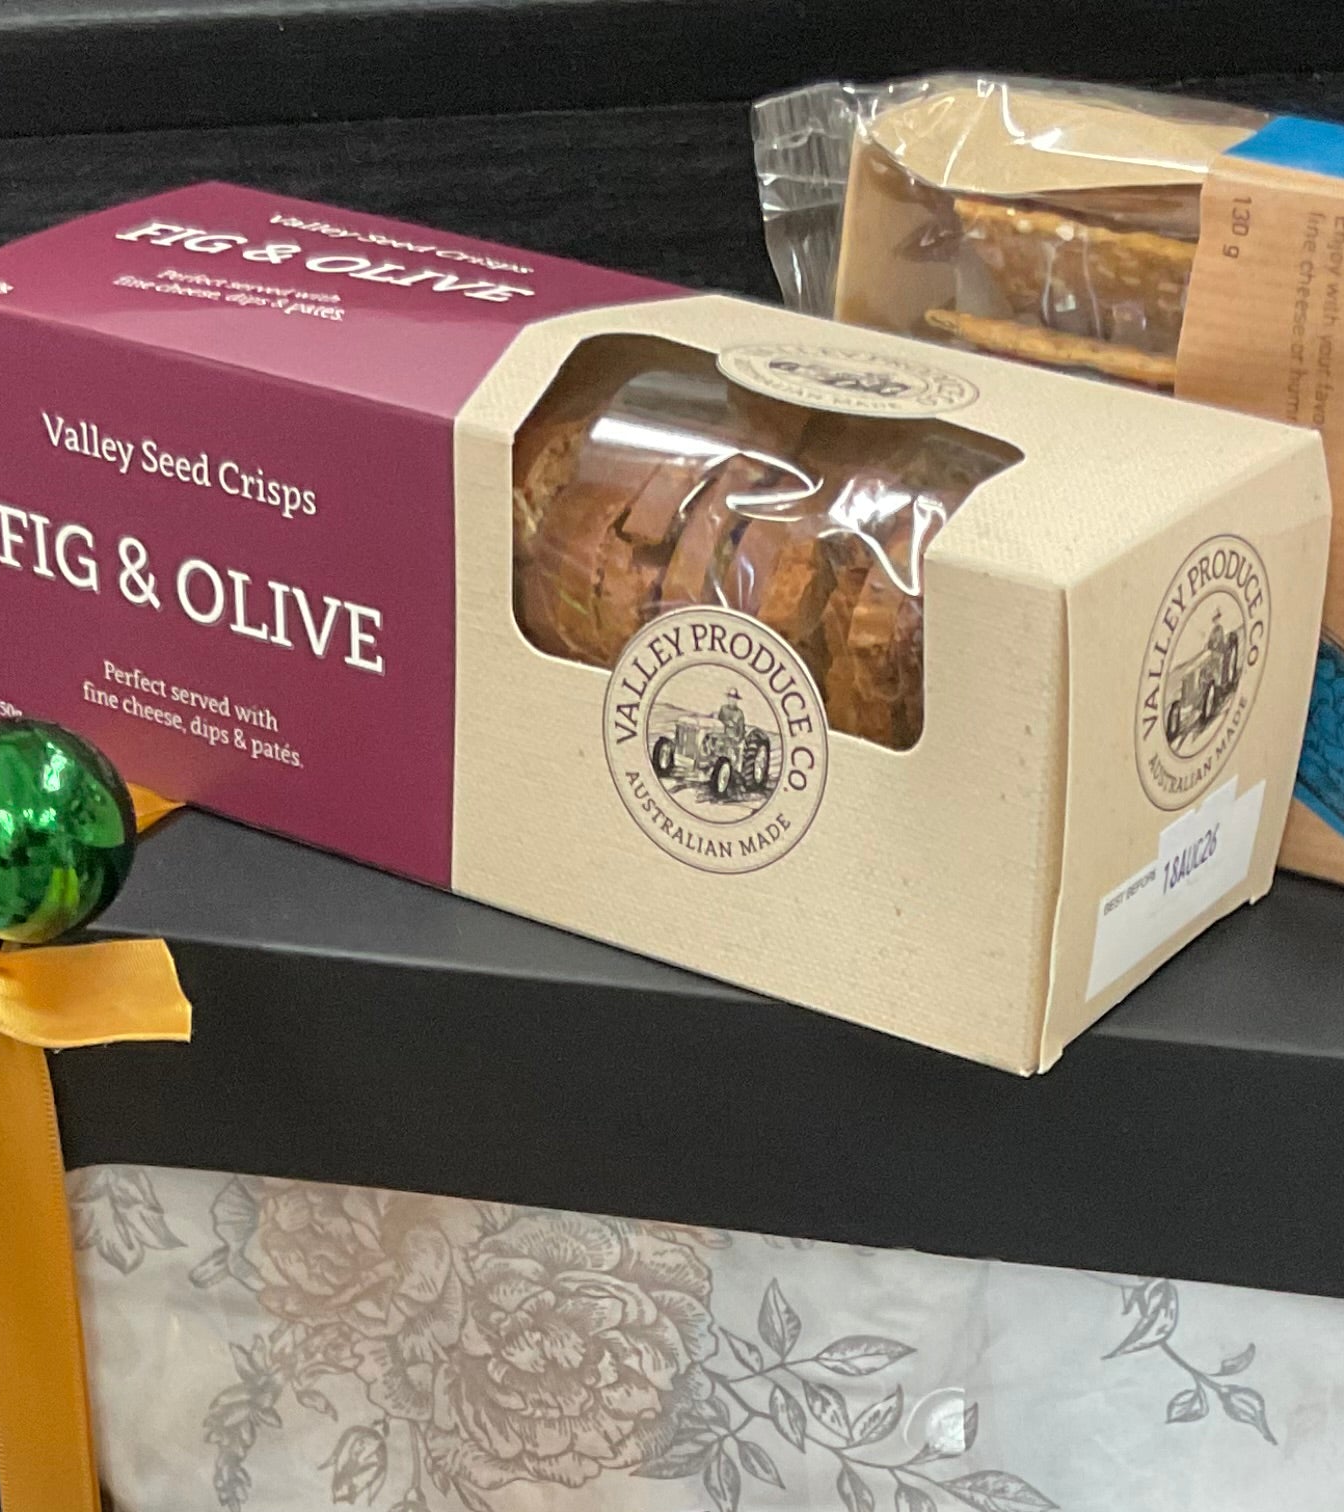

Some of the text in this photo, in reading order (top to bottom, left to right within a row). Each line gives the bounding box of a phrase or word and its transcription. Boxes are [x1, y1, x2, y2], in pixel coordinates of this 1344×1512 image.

[114, 220, 536, 302] FIG & OLIVE
[1223, 196, 1253, 260] 130 g
[1291, 211, 1327, 337] fine cheese
[1321, 282, 1343, 328] with
[1316, 335, 1334, 378] your
[40, 410, 319, 519] Valley Seed Crisps
[116, 535, 162, 611] &
[175, 557, 387, 677] OLIVE
[1141, 583, 1188, 742] VALLEY
[1187, 549, 1265, 620] PRODUCE
[82, 681, 120, 710] fine
[122, 692, 189, 735] cheese,
[189, 715, 230, 747] dips
[233, 728, 248, 750] &
[103, 659, 280, 733] Perfect served with
[613, 622, 815, 793] VALLEY PRODUCE CO.
[1147, 694, 1250, 795] AUSTRALIAN MADE
[625, 770, 792, 858] AUSTRALIAN MADE
